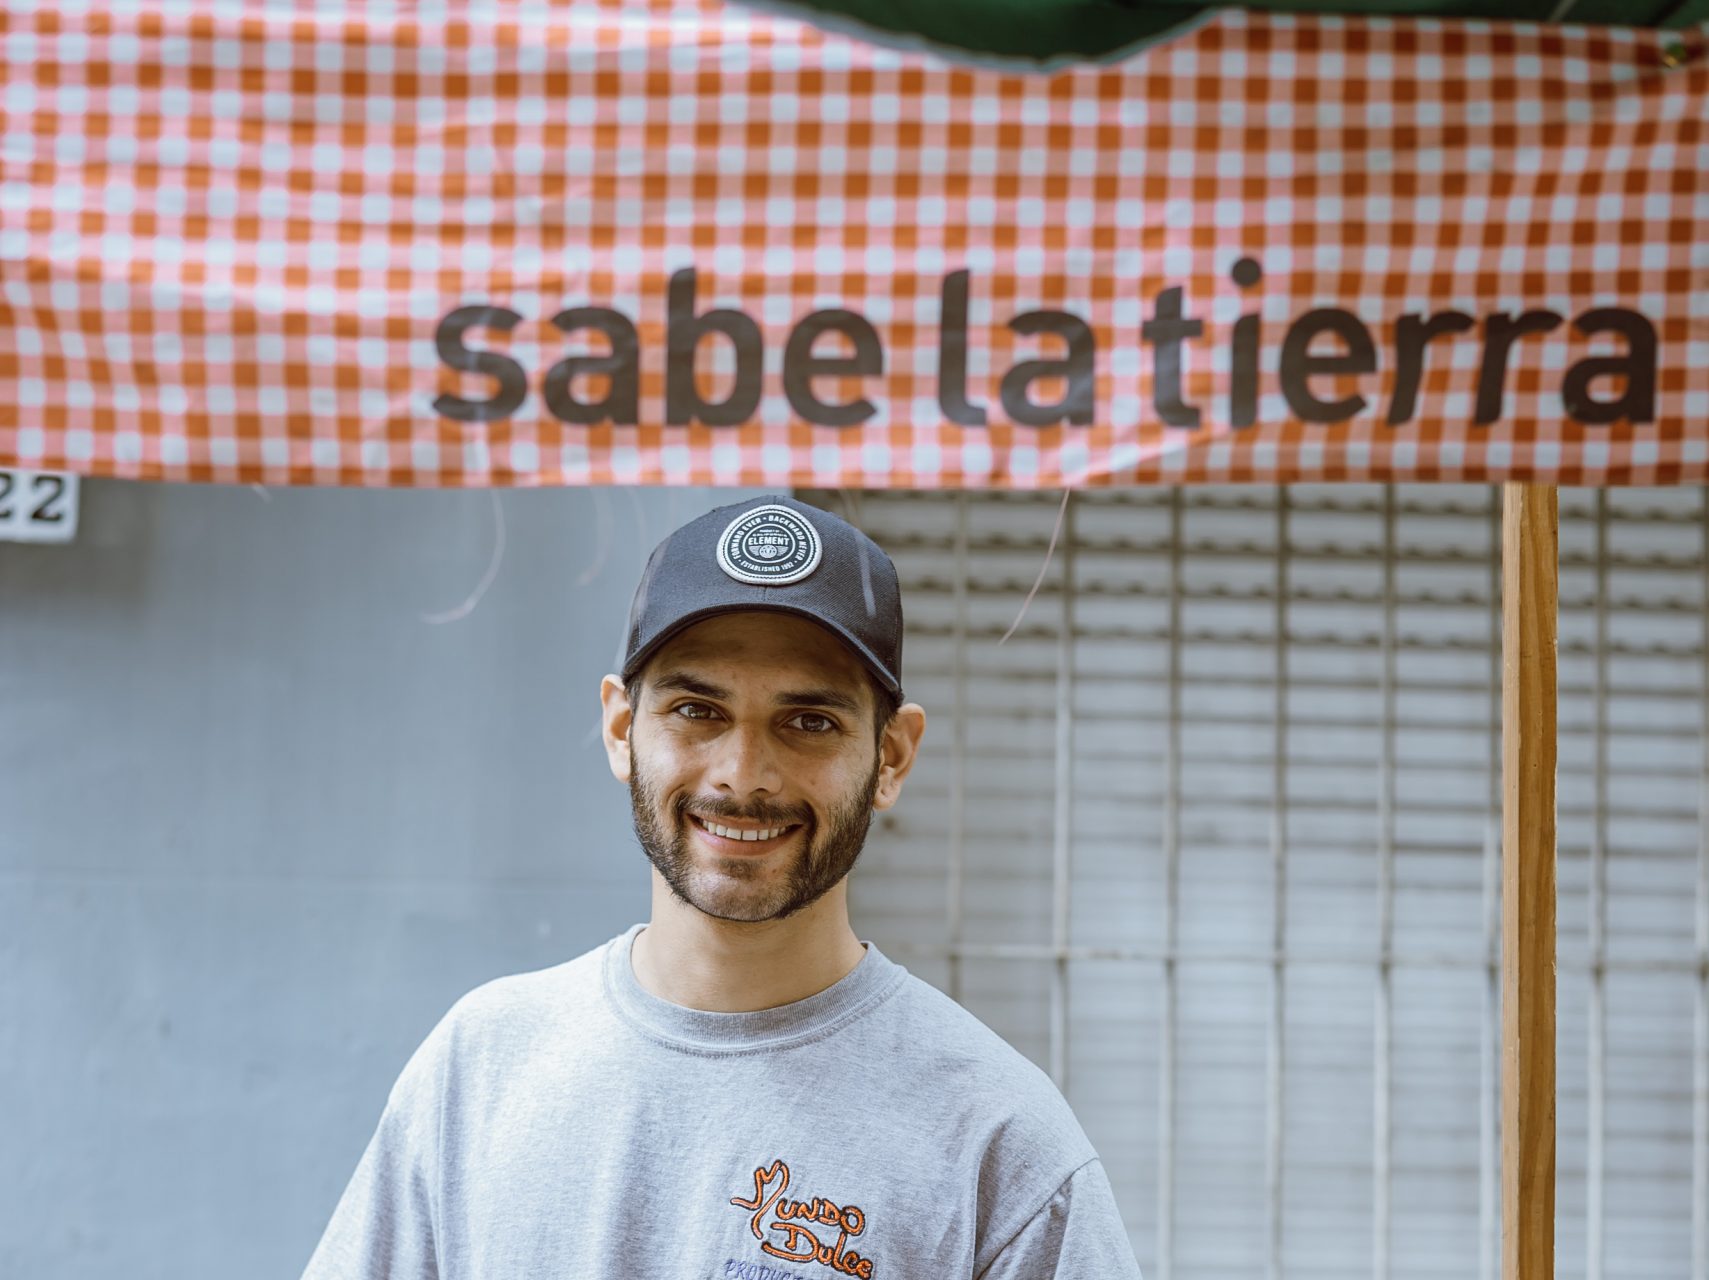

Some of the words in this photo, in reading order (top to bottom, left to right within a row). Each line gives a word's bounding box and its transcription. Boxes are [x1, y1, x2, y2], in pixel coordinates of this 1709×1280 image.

[432, 266, 884, 428] sabe
[937, 268, 1096, 428] la
[1141, 256, 1659, 430] tierra
[741, 516, 762, 531] EVER
[768, 514, 806, 540] BACKWARD
[795, 540, 807, 561] NEVER
[747, 536, 790, 545] ELEMENT
[740, 560, 780, 572] ESTABLISHED
